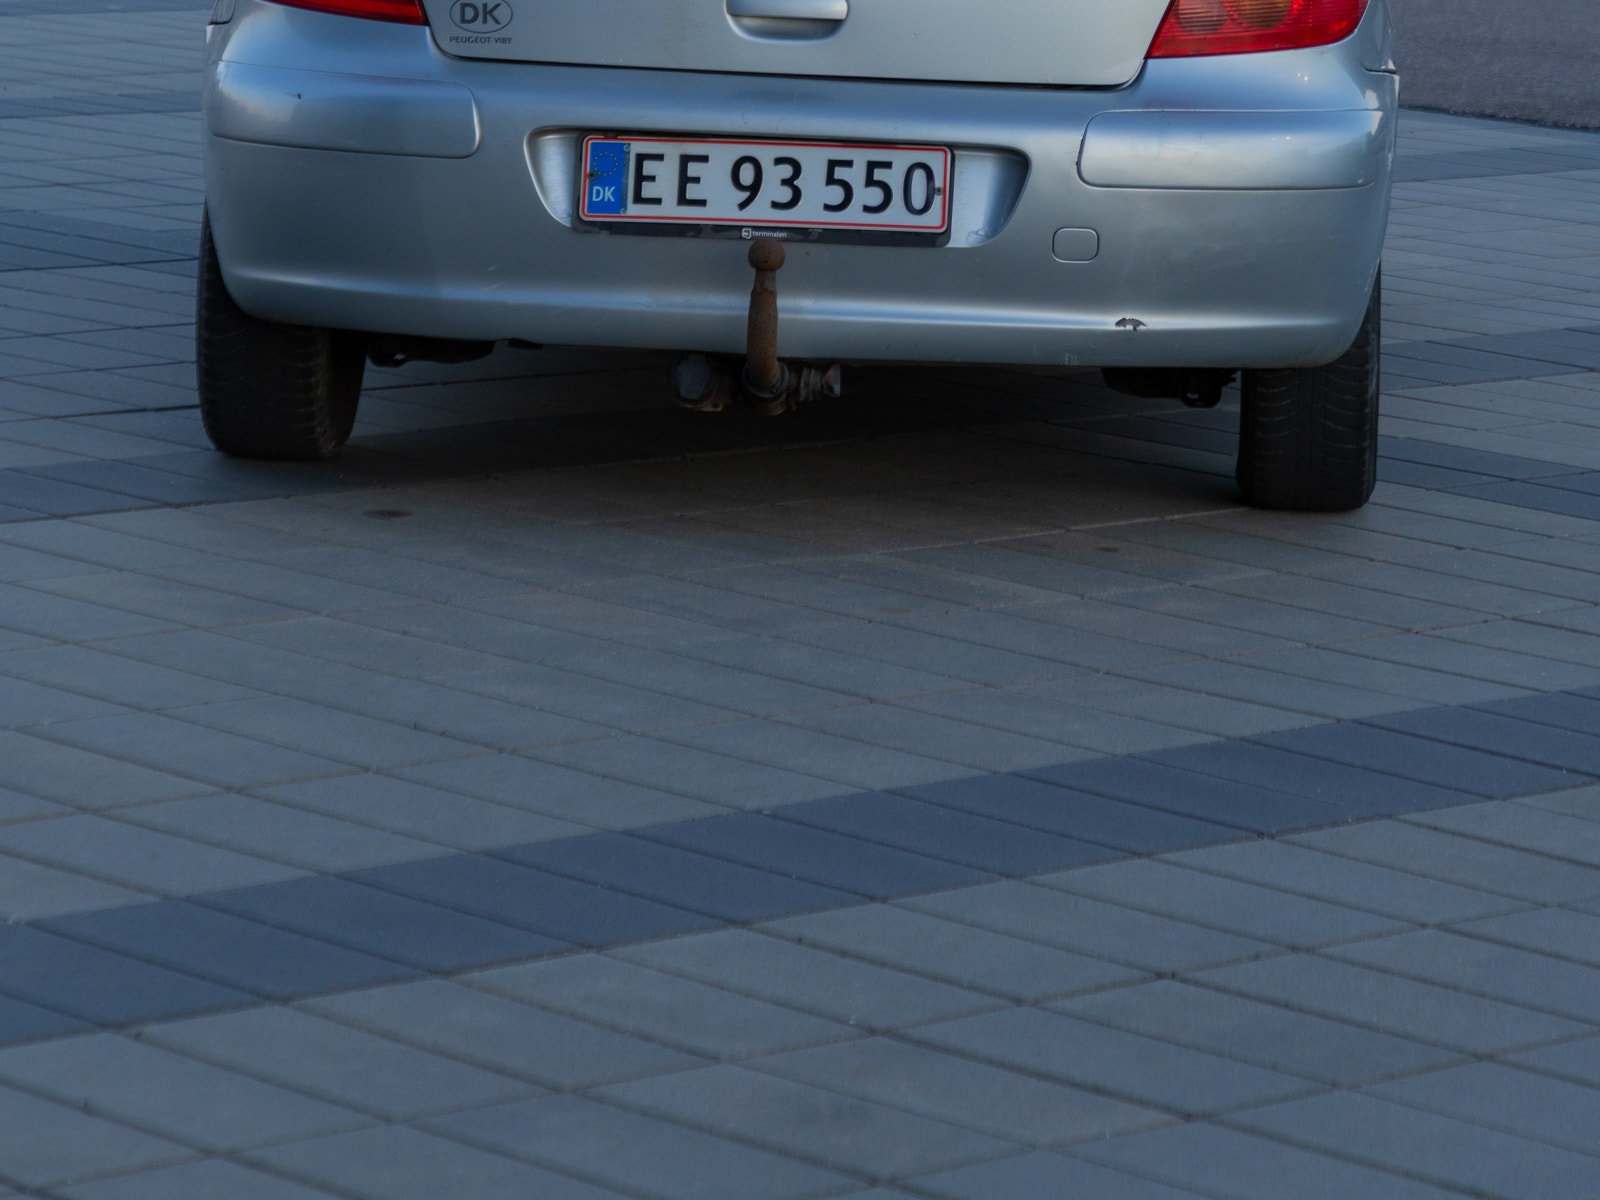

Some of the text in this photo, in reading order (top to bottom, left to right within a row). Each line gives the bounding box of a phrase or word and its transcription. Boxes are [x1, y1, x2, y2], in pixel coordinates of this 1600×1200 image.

[459, 2, 503, 25] DK
[449, 36, 491, 44] PEUGEOT
[592, 186, 615, 202] DK
[632, 153, 936, 216] EE 93 550
